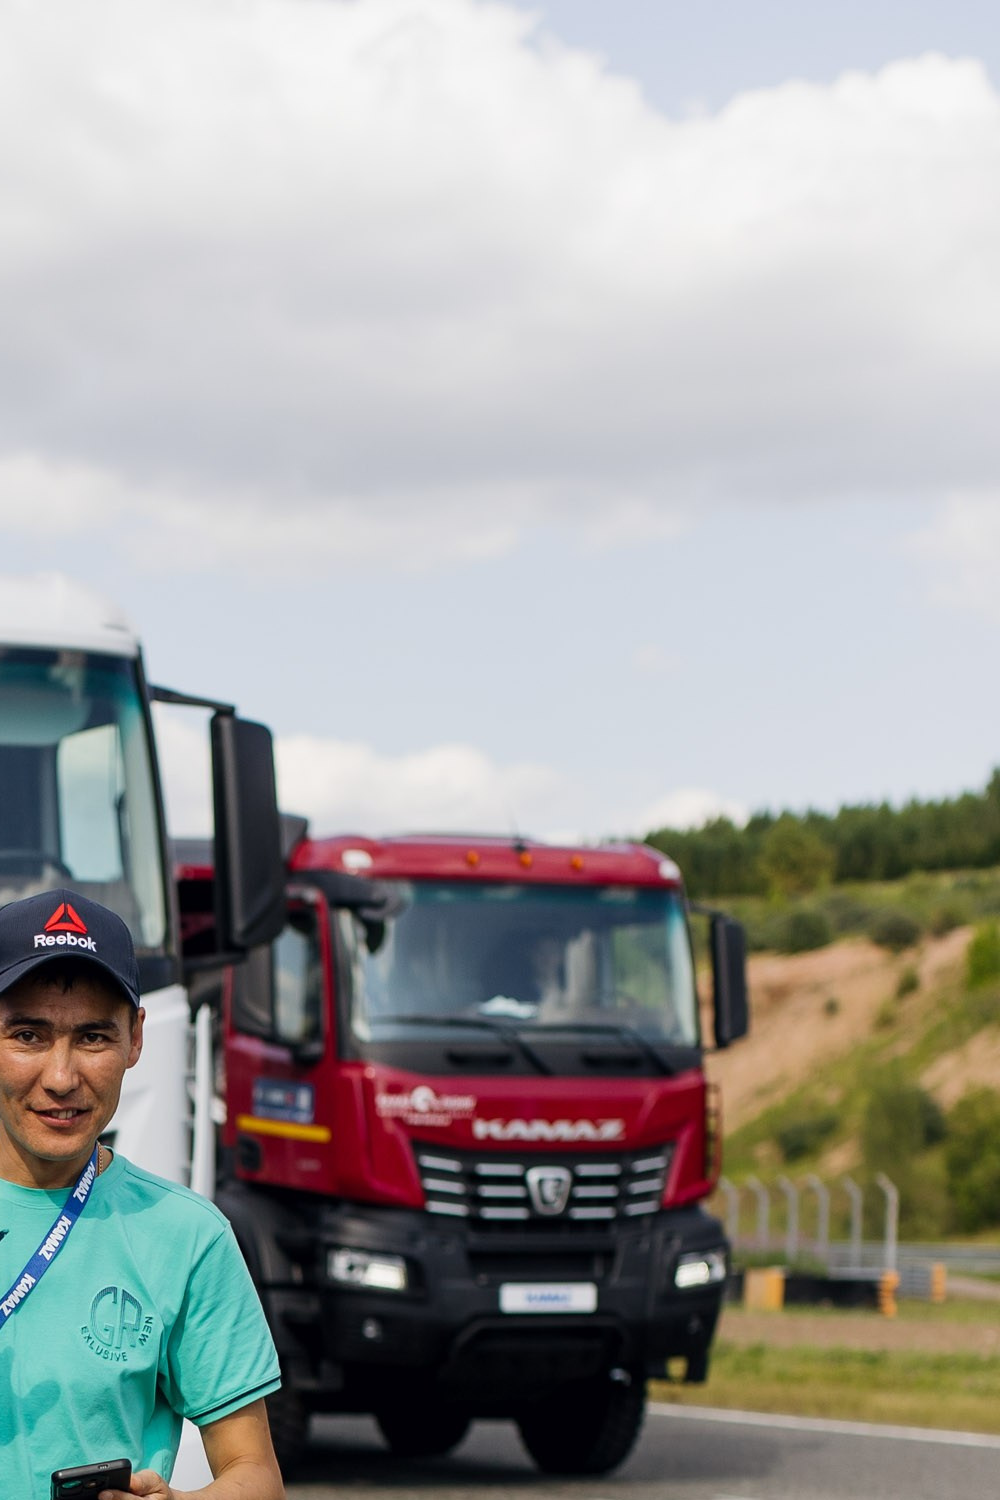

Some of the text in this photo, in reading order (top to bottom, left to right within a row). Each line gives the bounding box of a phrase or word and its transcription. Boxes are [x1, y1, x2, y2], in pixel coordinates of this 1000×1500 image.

[34, 933, 97, 952] Reebok
[472, 1117, 627, 1142] KAMAZ
[73, 1161, 96, 1203] KAMAZ
[39, 1215, 72, 1261] KAMAZ
[81, 1325, 129, 1362] EXLUSIVE
[138, 1315, 155, 1347] NEW
